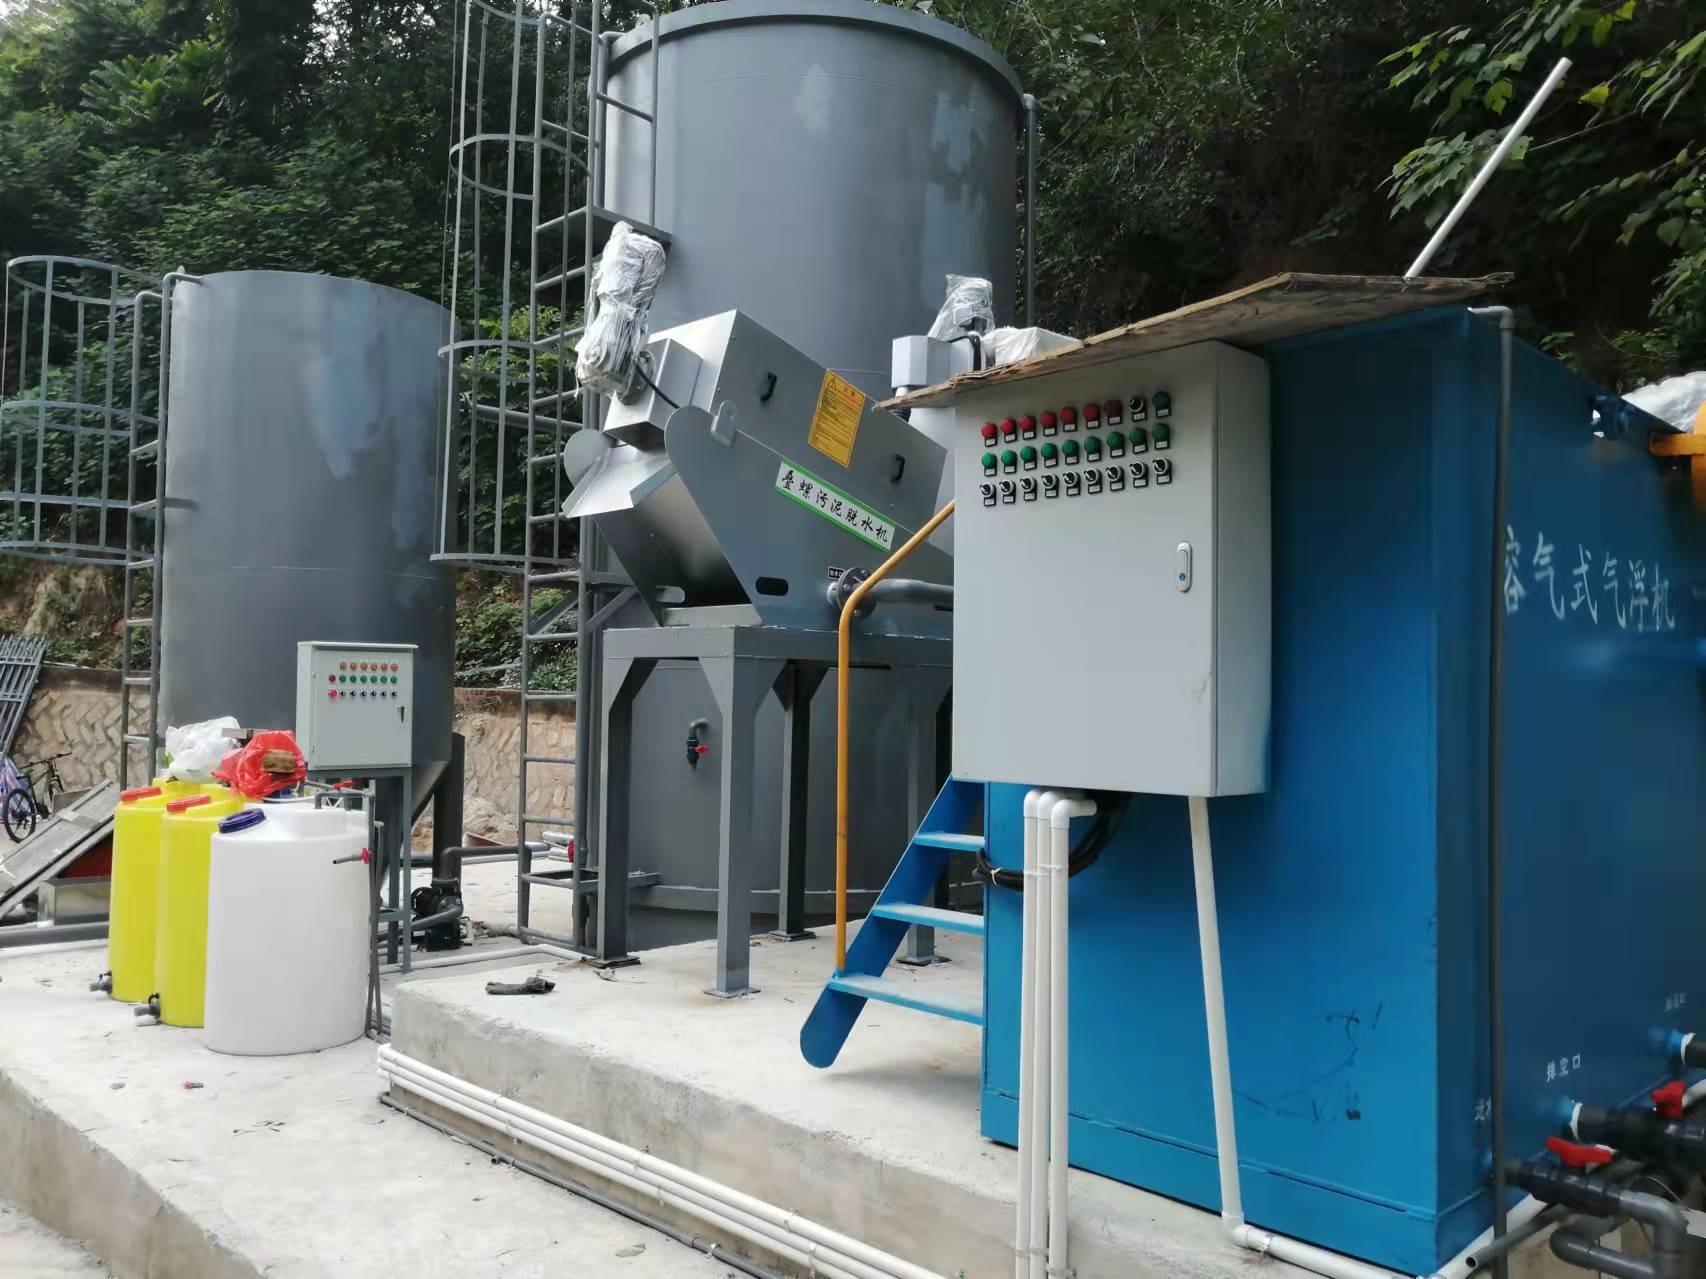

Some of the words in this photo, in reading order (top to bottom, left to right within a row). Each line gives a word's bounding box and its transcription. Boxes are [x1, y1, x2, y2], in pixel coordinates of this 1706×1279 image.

[781, 469, 888, 543] 叠螺污泥脱水机
